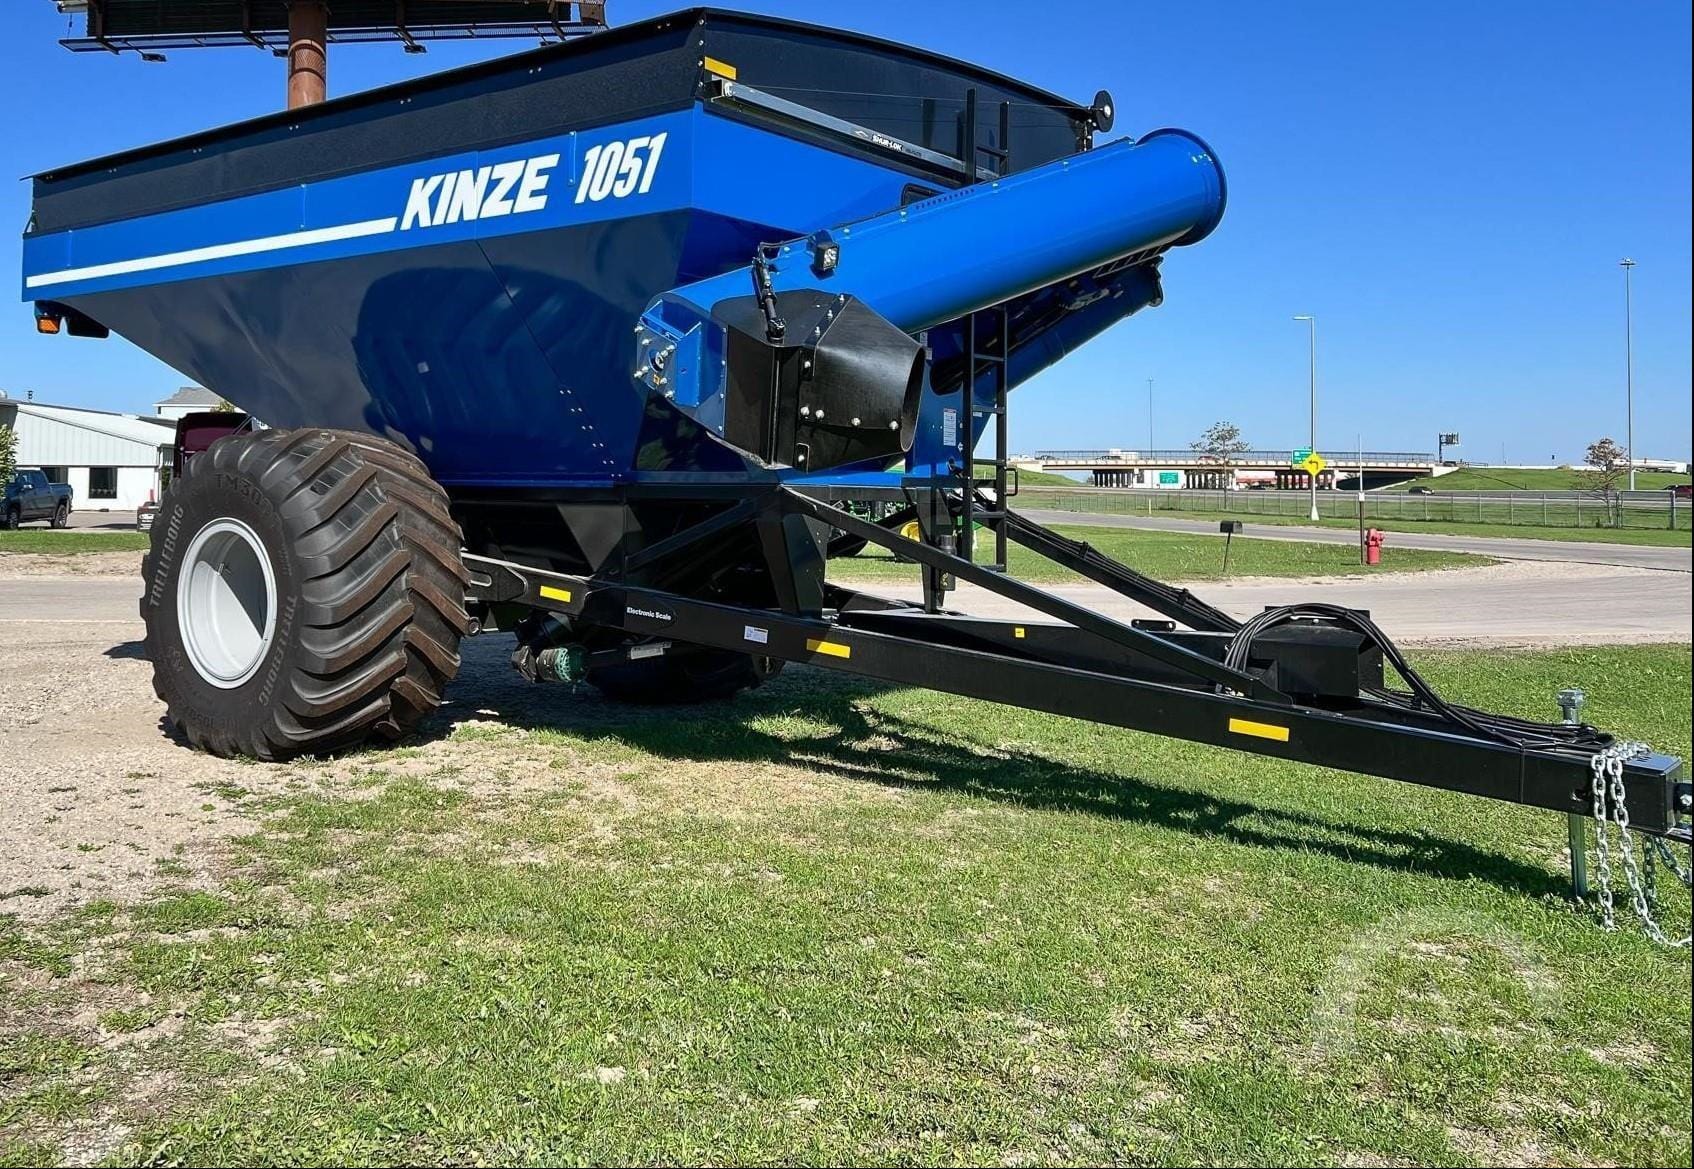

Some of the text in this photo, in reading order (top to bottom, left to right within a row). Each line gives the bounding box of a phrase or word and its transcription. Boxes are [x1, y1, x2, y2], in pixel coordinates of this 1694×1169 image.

[400, 132, 668, 231] KINZE 1051
[149, 503, 184, 607] TRELLEBORG
[258, 594, 298, 705] TRELLEBORG
[626, 606, 672, 621] Electronic Scale
